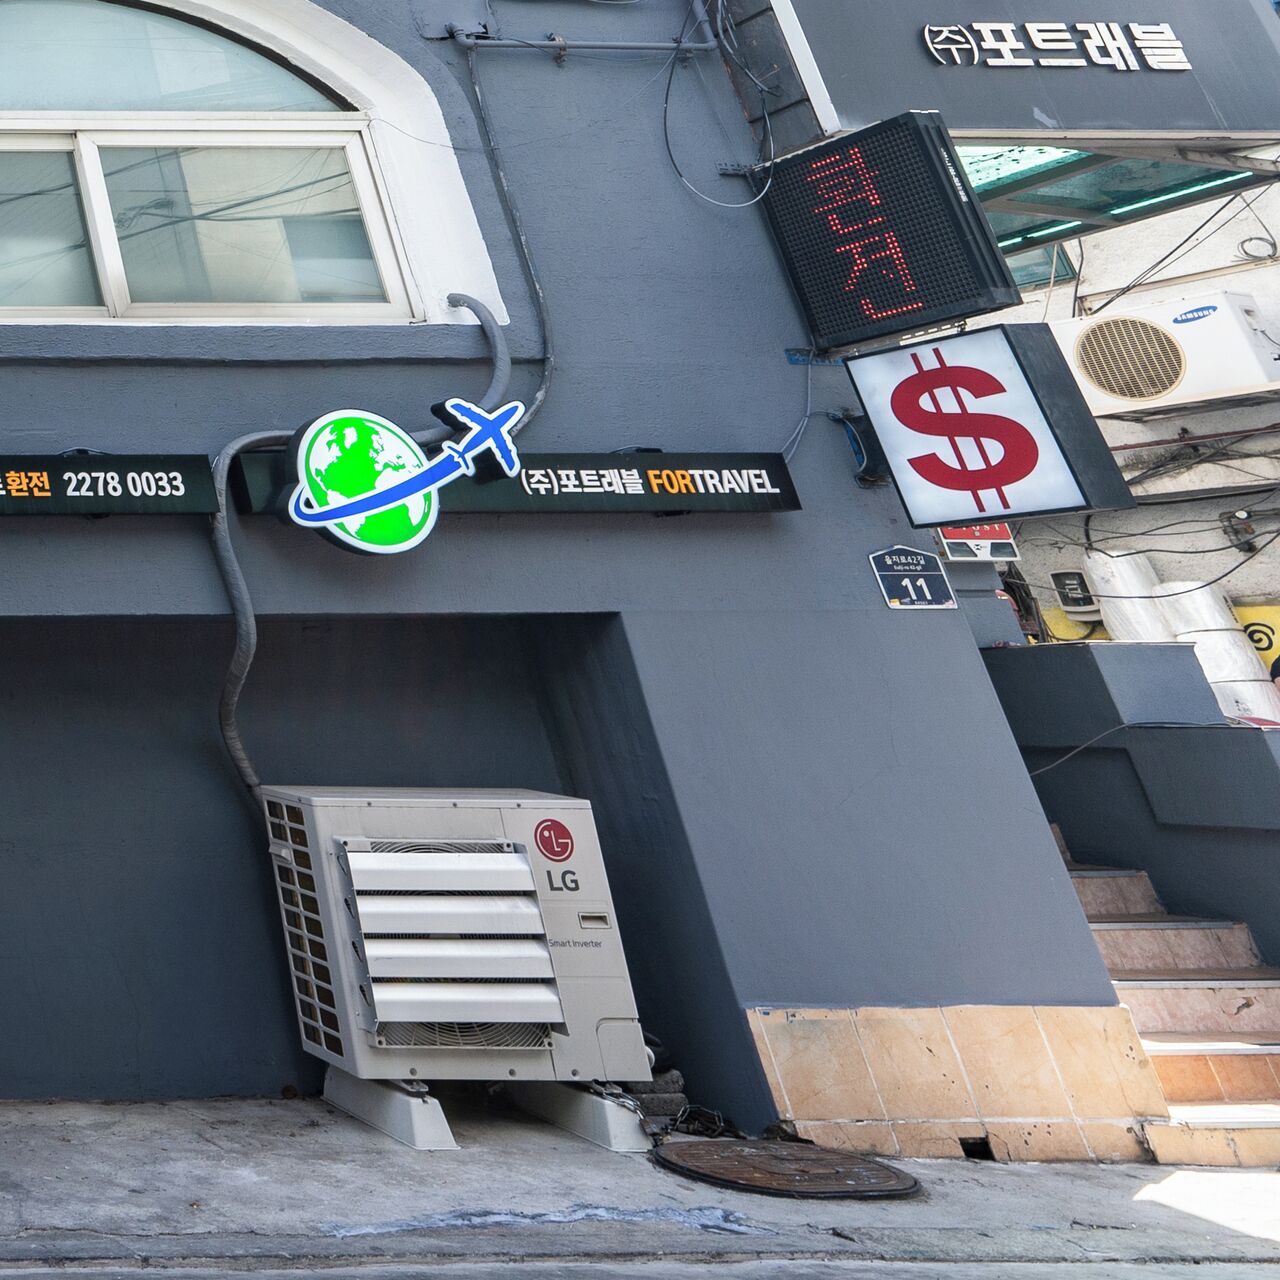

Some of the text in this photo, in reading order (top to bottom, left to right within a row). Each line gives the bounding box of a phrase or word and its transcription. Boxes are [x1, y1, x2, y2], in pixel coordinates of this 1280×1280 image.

[924, 22, 1192, 71] (주)포트래블
[806, 147, 924, 319] 환전
[1177, 308, 1214, 321] SAMSUNG
[64, 472, 121, 497] 2278
[127, 472, 185, 497] 0033
[521, 468, 780, 496] (주)포트래블 FORTRAVEL
[901, 577, 932, 601] 11
[546, 869, 580, 893] LG
[549, 938, 572, 948] Smart
